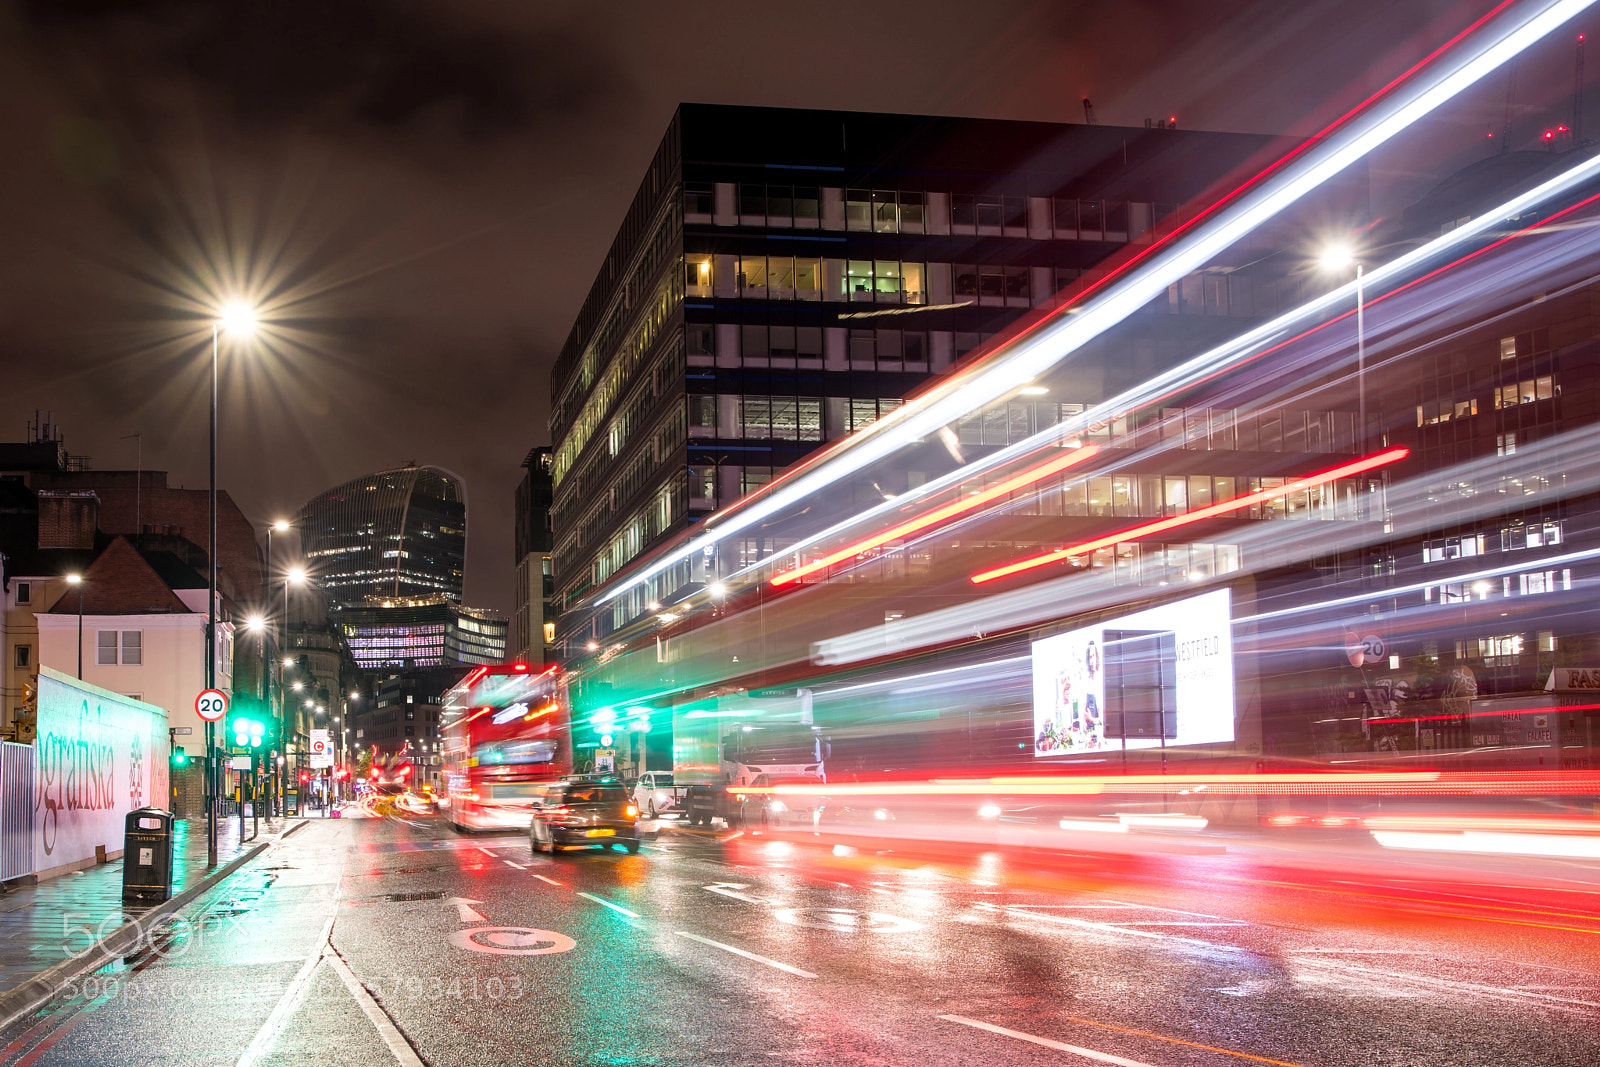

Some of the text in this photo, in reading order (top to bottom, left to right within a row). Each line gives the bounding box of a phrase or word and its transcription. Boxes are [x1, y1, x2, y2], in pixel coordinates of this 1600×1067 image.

[1362, 641, 1384, 657] 20
[200, 698, 223, 713] 20
[1527, 731, 1553, 742] FALAFEL
